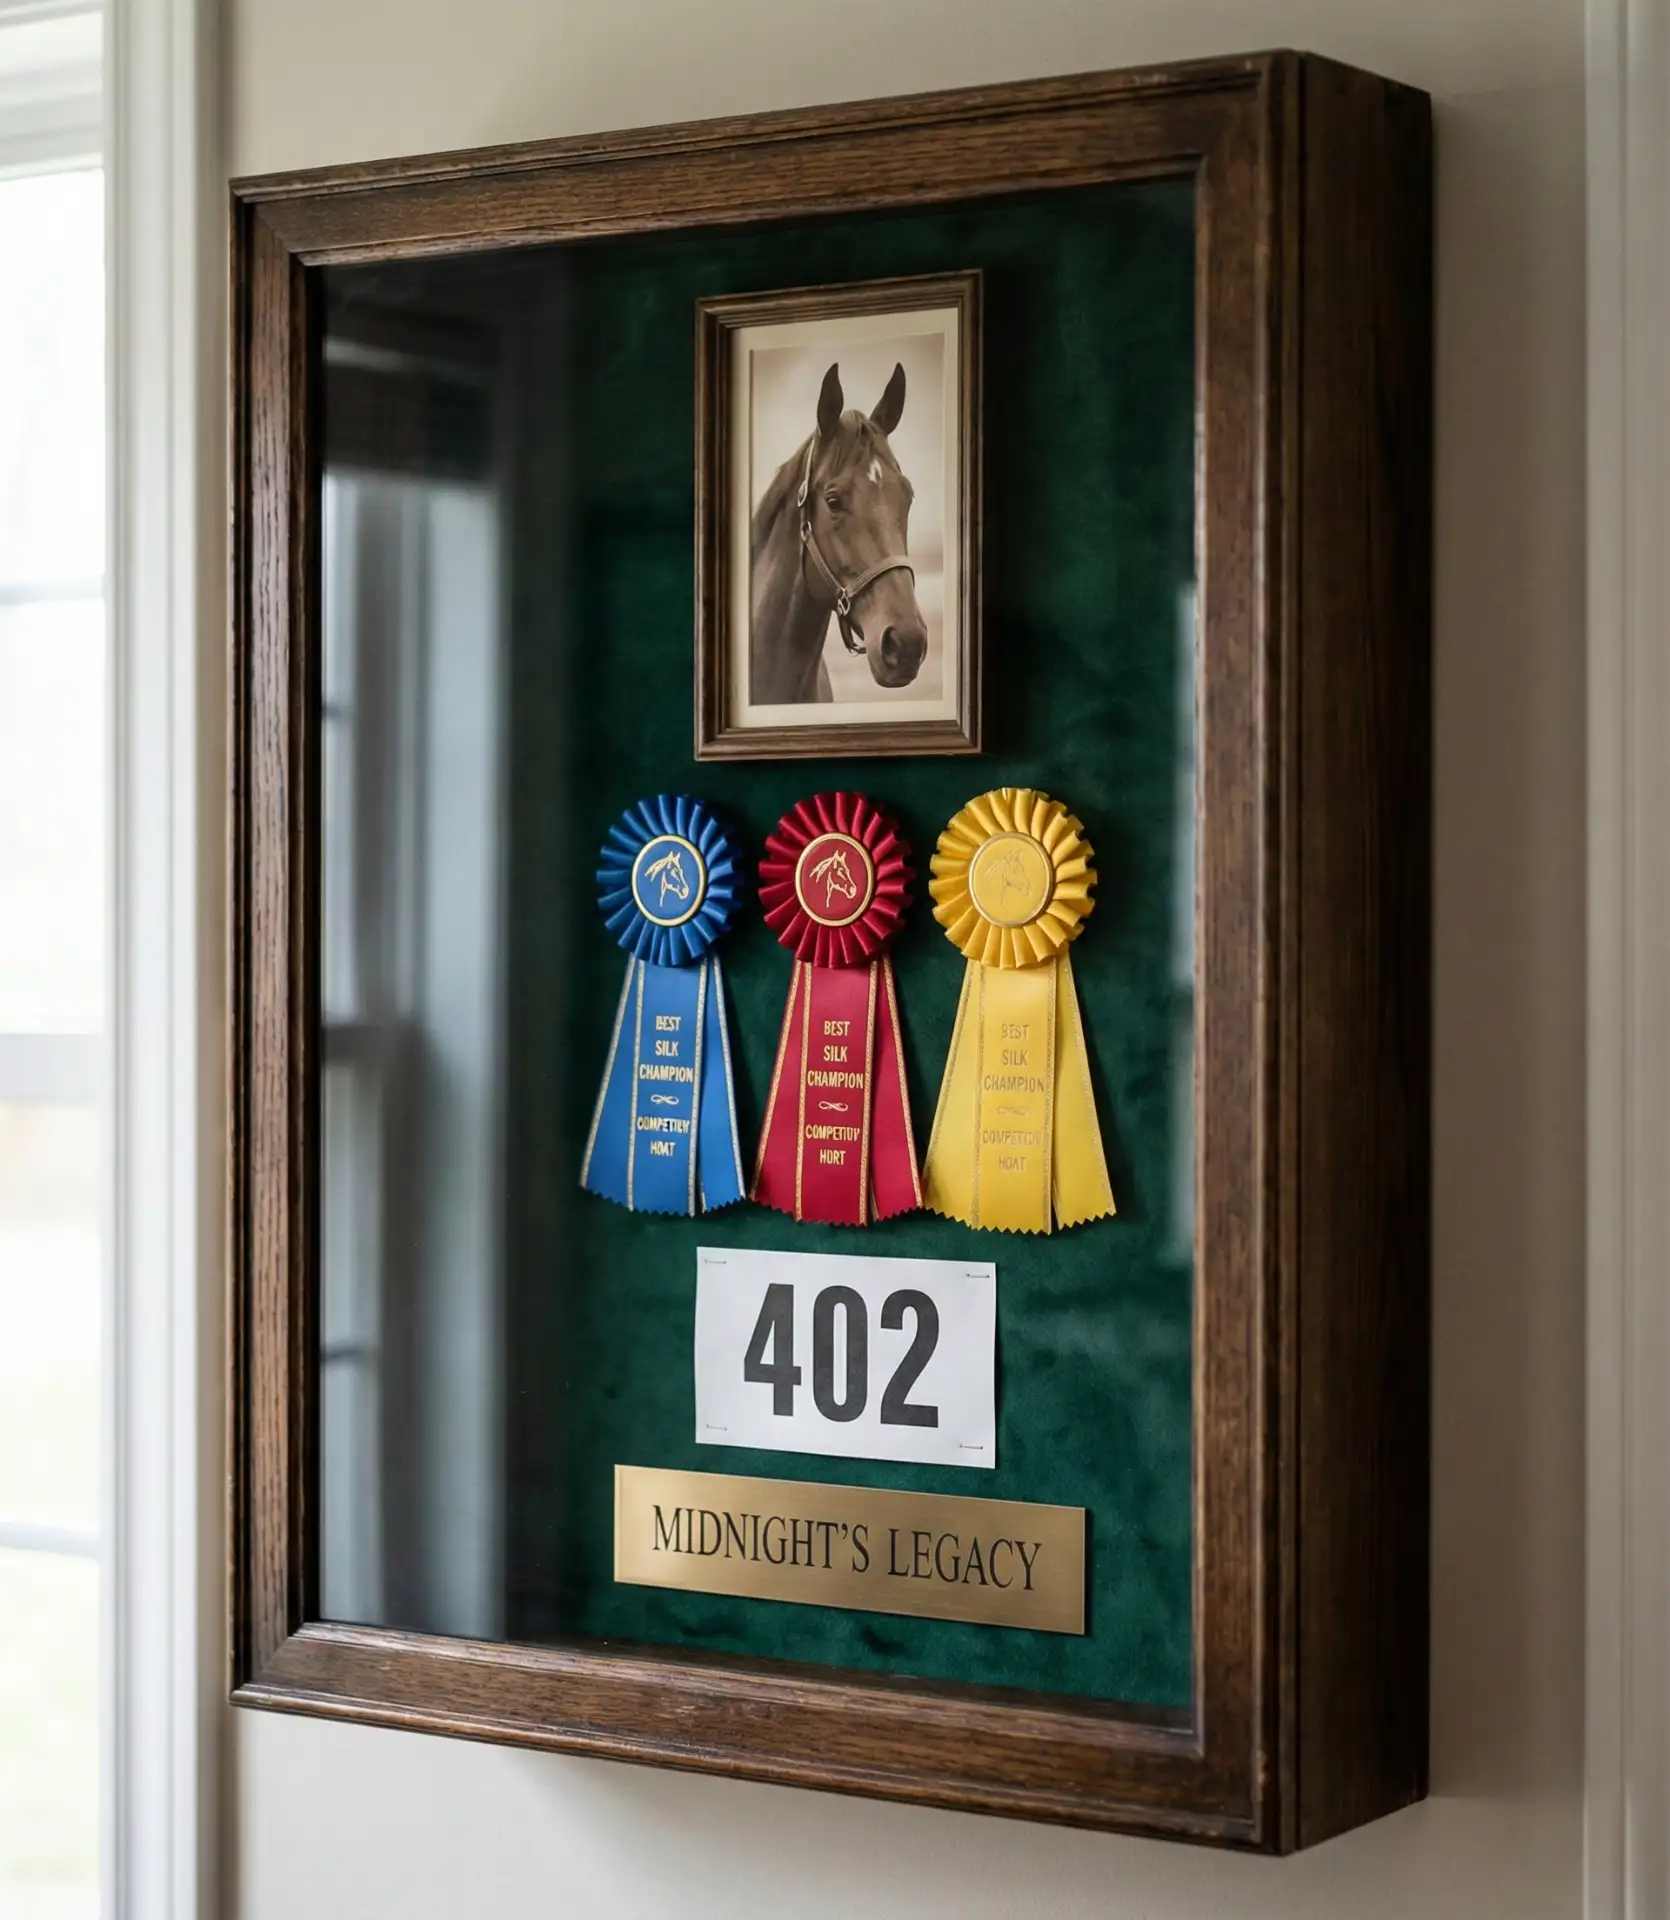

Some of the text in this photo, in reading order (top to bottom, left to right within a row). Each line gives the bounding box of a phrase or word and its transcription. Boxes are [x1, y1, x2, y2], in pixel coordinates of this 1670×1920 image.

[655, 1015, 681, 1031] BEST
[824, 1020, 850, 1036] BEST
[1001, 1024, 1030, 1039] BEST
[655, 1040, 679, 1056] SILK
[823, 1045, 848, 1062] SILK
[1002, 1050, 1028, 1066] SILK
[639, 1064, 694, 1082] CHAMPION
[807, 1070, 864, 1089] CHAMPION
[984, 1075, 1045, 1092] CHAMPION
[743, 1283, 940, 1428] 402
[652, 1504, 1042, 1591] MIDNIGHT'S LEGACY
